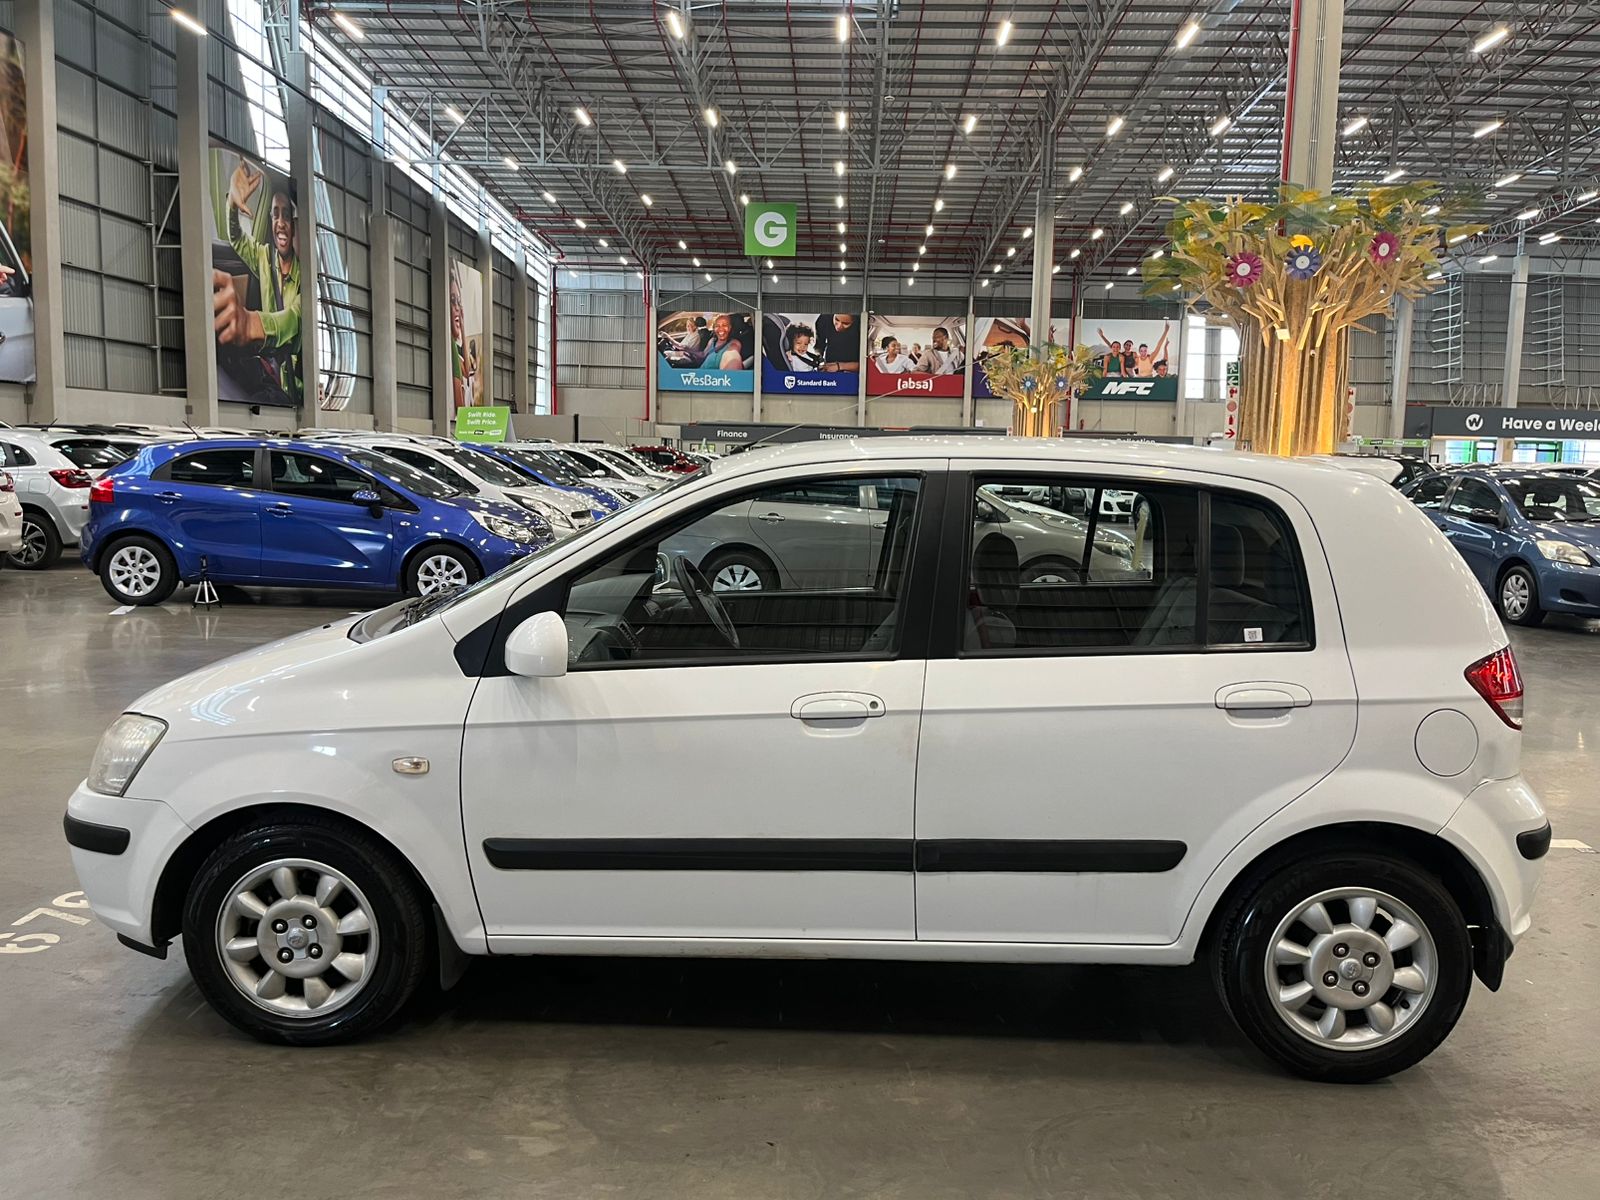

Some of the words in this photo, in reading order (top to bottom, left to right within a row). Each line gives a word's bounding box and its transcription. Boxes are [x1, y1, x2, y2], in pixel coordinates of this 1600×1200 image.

[754, 211, 788, 248] G
[681, 372, 731, 387] WesBank
[797, 379, 822, 387] Standard
[822, 379, 837, 387] Bank
[1101, 381, 1155, 396] MFC
[466, 418, 481, 426] Swift
[1502, 417, 1543, 430] Have
[1545, 420, 1556, 431] a
[1559, 418, 1600, 432] Weel
[716, 429, 748, 438] Finance
[819, 432, 859, 440] Insurance
